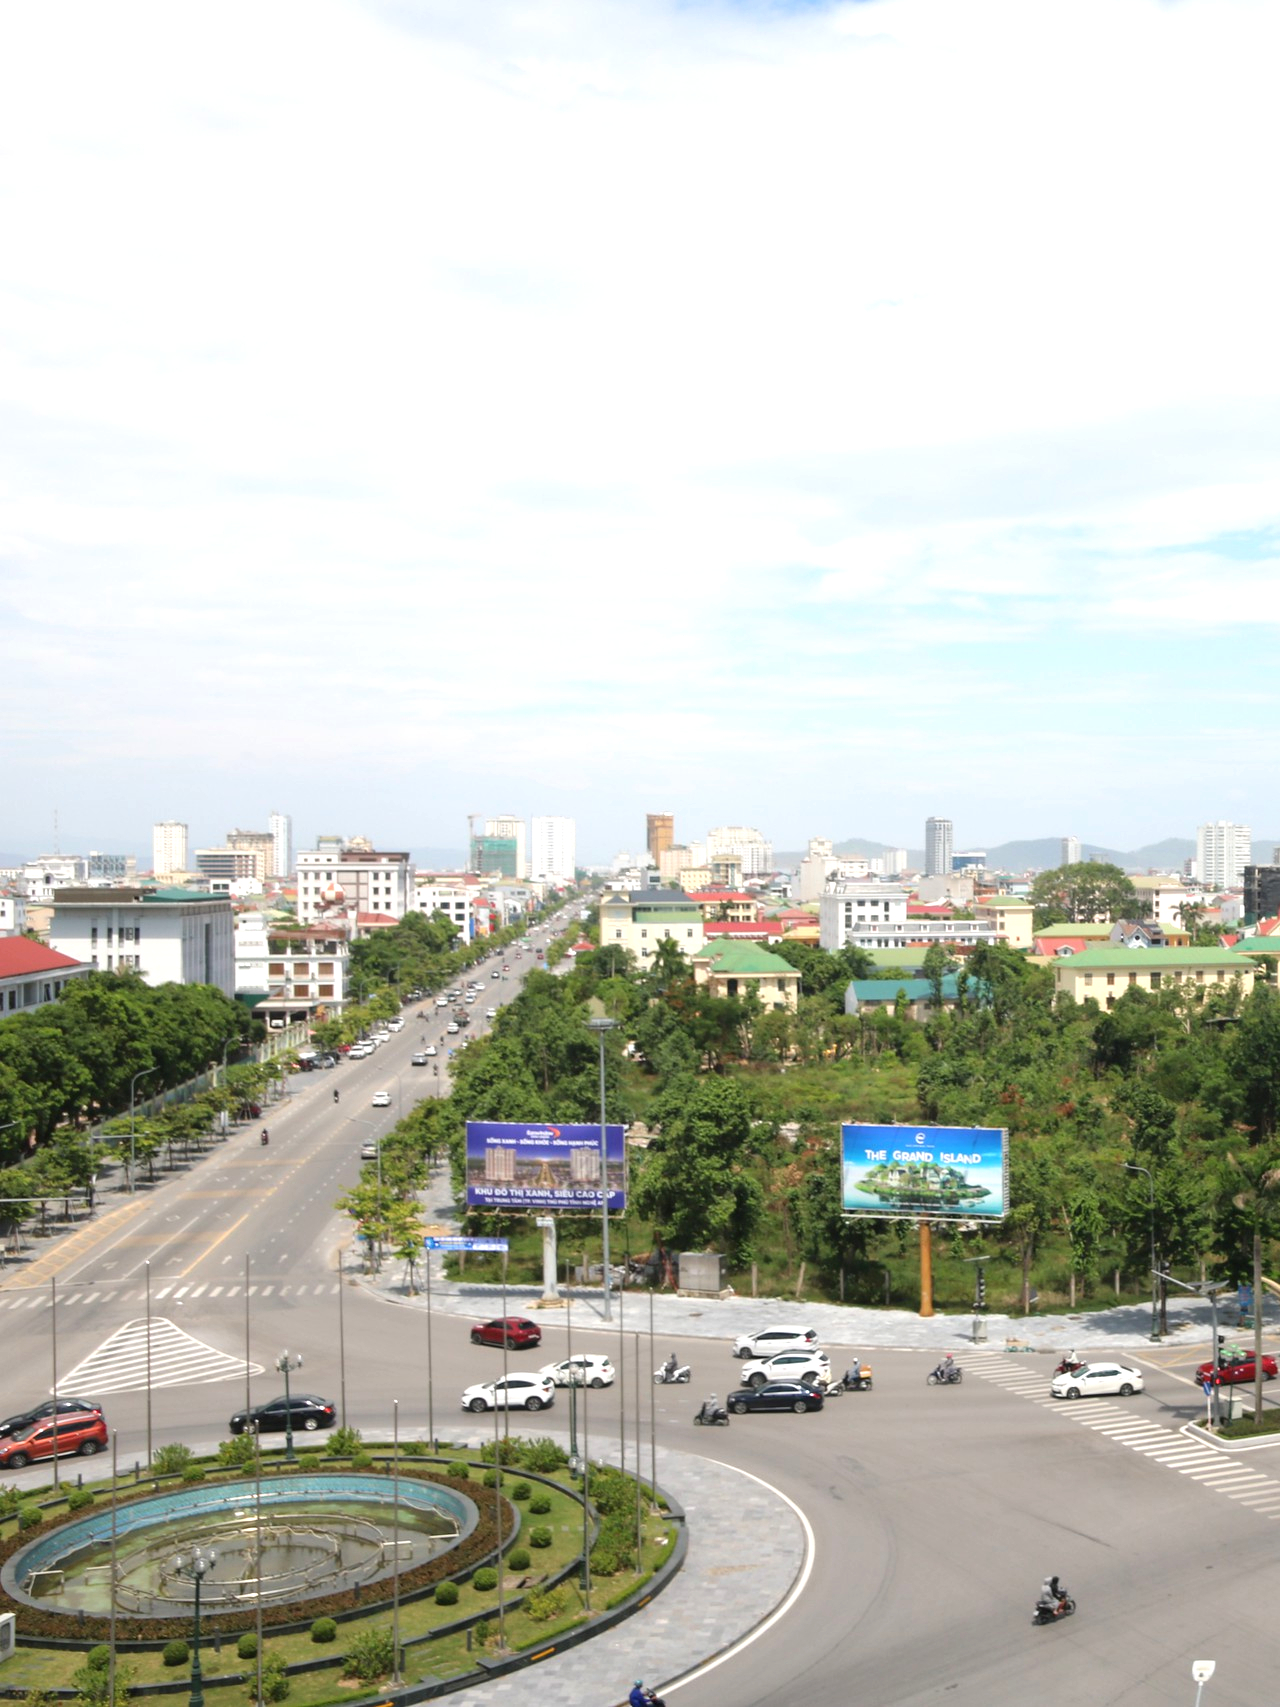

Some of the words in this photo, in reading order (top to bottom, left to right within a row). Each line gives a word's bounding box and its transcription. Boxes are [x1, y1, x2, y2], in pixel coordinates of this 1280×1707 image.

[864, 1149, 887, 1161] THE
[893, 1151, 934, 1163] GRAND
[940, 1152, 982, 1164] ISLAND
[475, 1188, 493, 1196] KHU
[494, 1188, 508, 1197] ĐÔ
[509, 1189, 524, 1198] THỊ
[525, 1189, 552, 1199] XANH,
[554, 1189, 574, 1198] SIÊU
